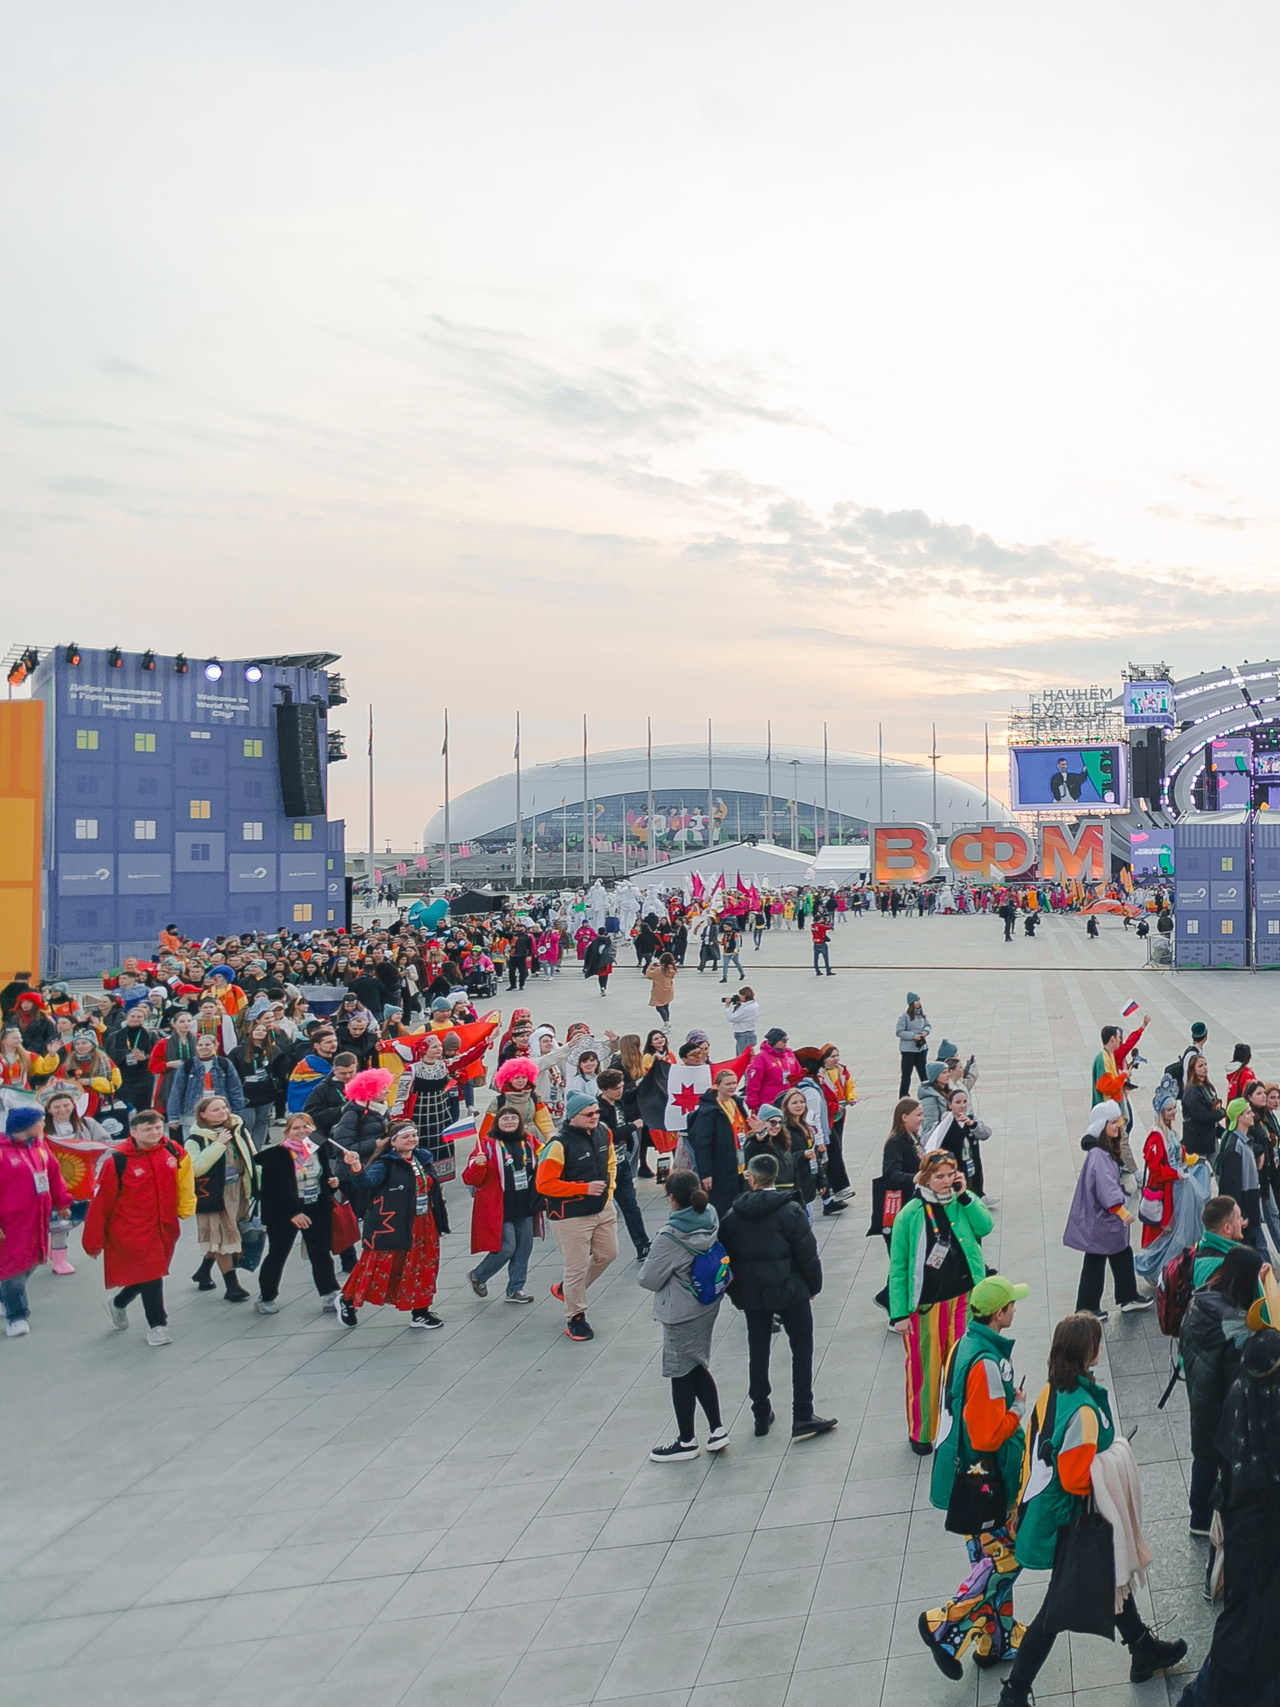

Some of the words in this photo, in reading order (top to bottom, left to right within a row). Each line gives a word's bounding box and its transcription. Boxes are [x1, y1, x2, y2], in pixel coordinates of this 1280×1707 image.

[196, 693, 238, 703] Welcome
[1043, 684, 1113, 701] НАЧНЁМ
[196, 701, 223, 710] World
[224, 703, 250, 711] Youth
[1032, 701, 1113, 717] БУДУЩЕЕ
[211, 710, 235, 719] City!
[870, 819, 1113, 884] ВФМ
